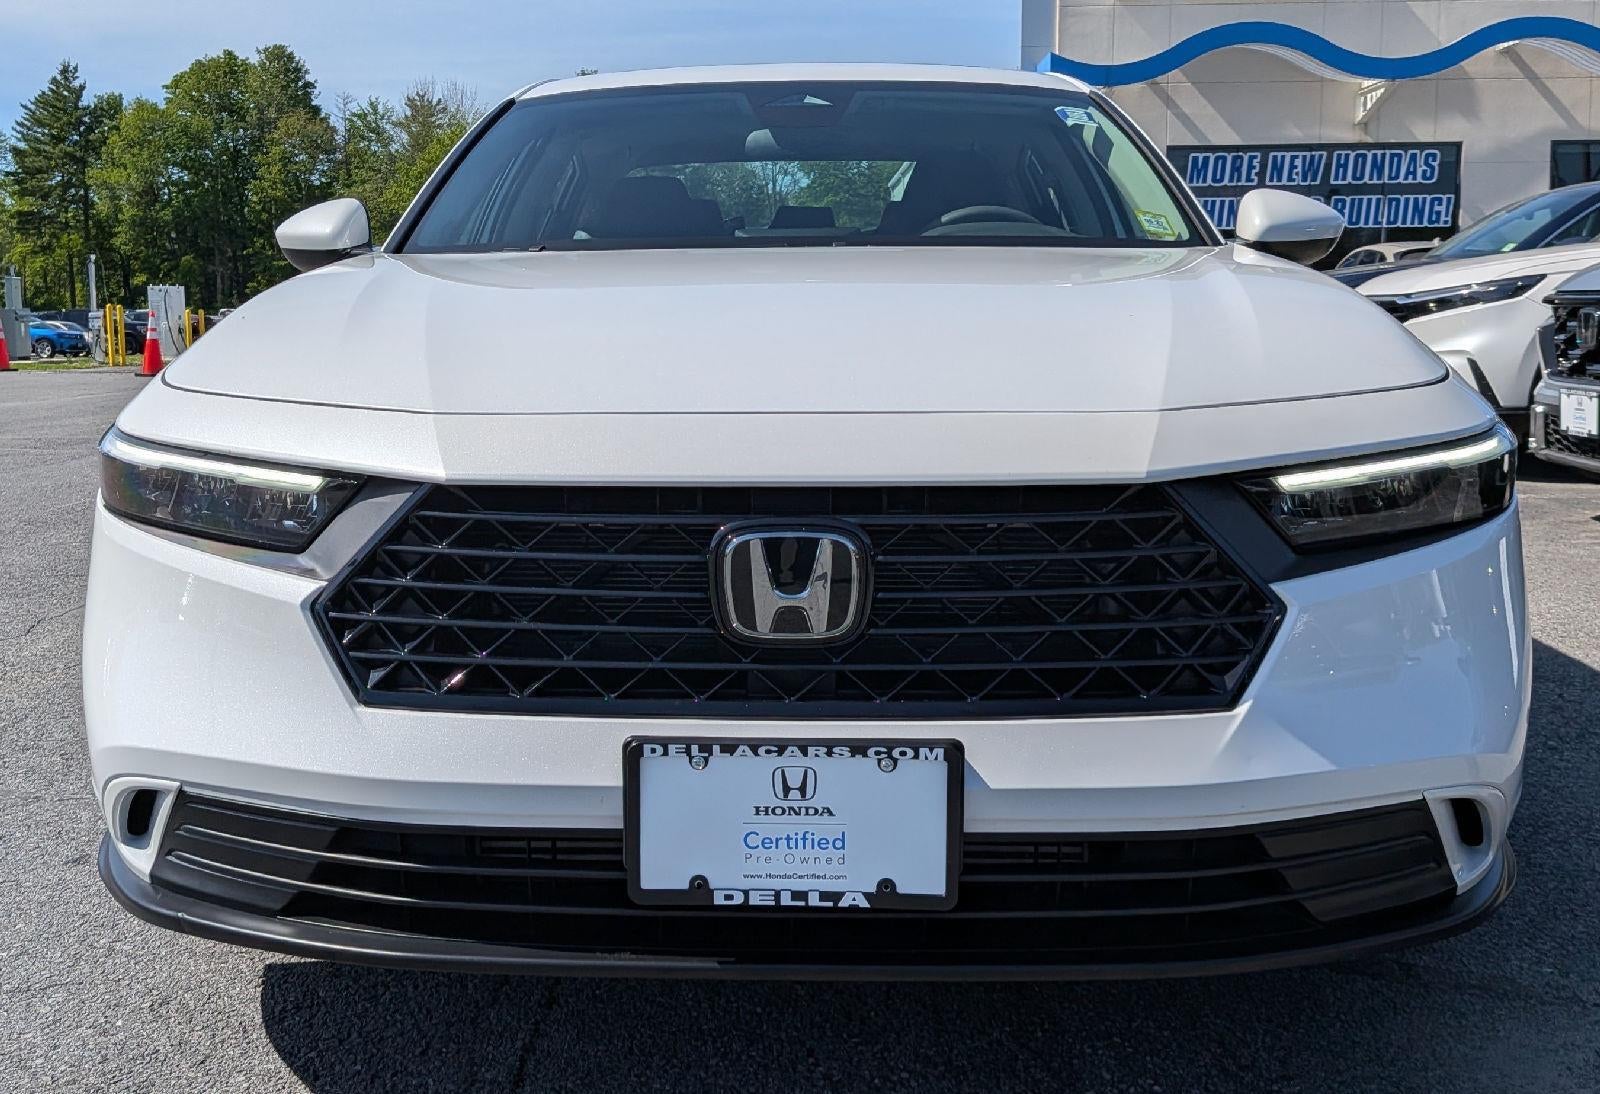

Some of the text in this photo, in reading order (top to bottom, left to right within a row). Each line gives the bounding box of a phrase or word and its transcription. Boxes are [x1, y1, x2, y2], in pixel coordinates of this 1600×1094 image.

[1187, 150, 1440, 185] MORE NEW HONDAS
[1331, 195, 1454, 228] BUILDING!
[643, 744, 945, 760] DELLACARS.COM
[753, 806, 836, 817] HONDA
[743, 831, 846, 851] Certified
[744, 853, 846, 865] Pre-Owned
[742, 873, 848, 881] www.HondaCertified.com
[713, 889, 871, 908] DELLA
